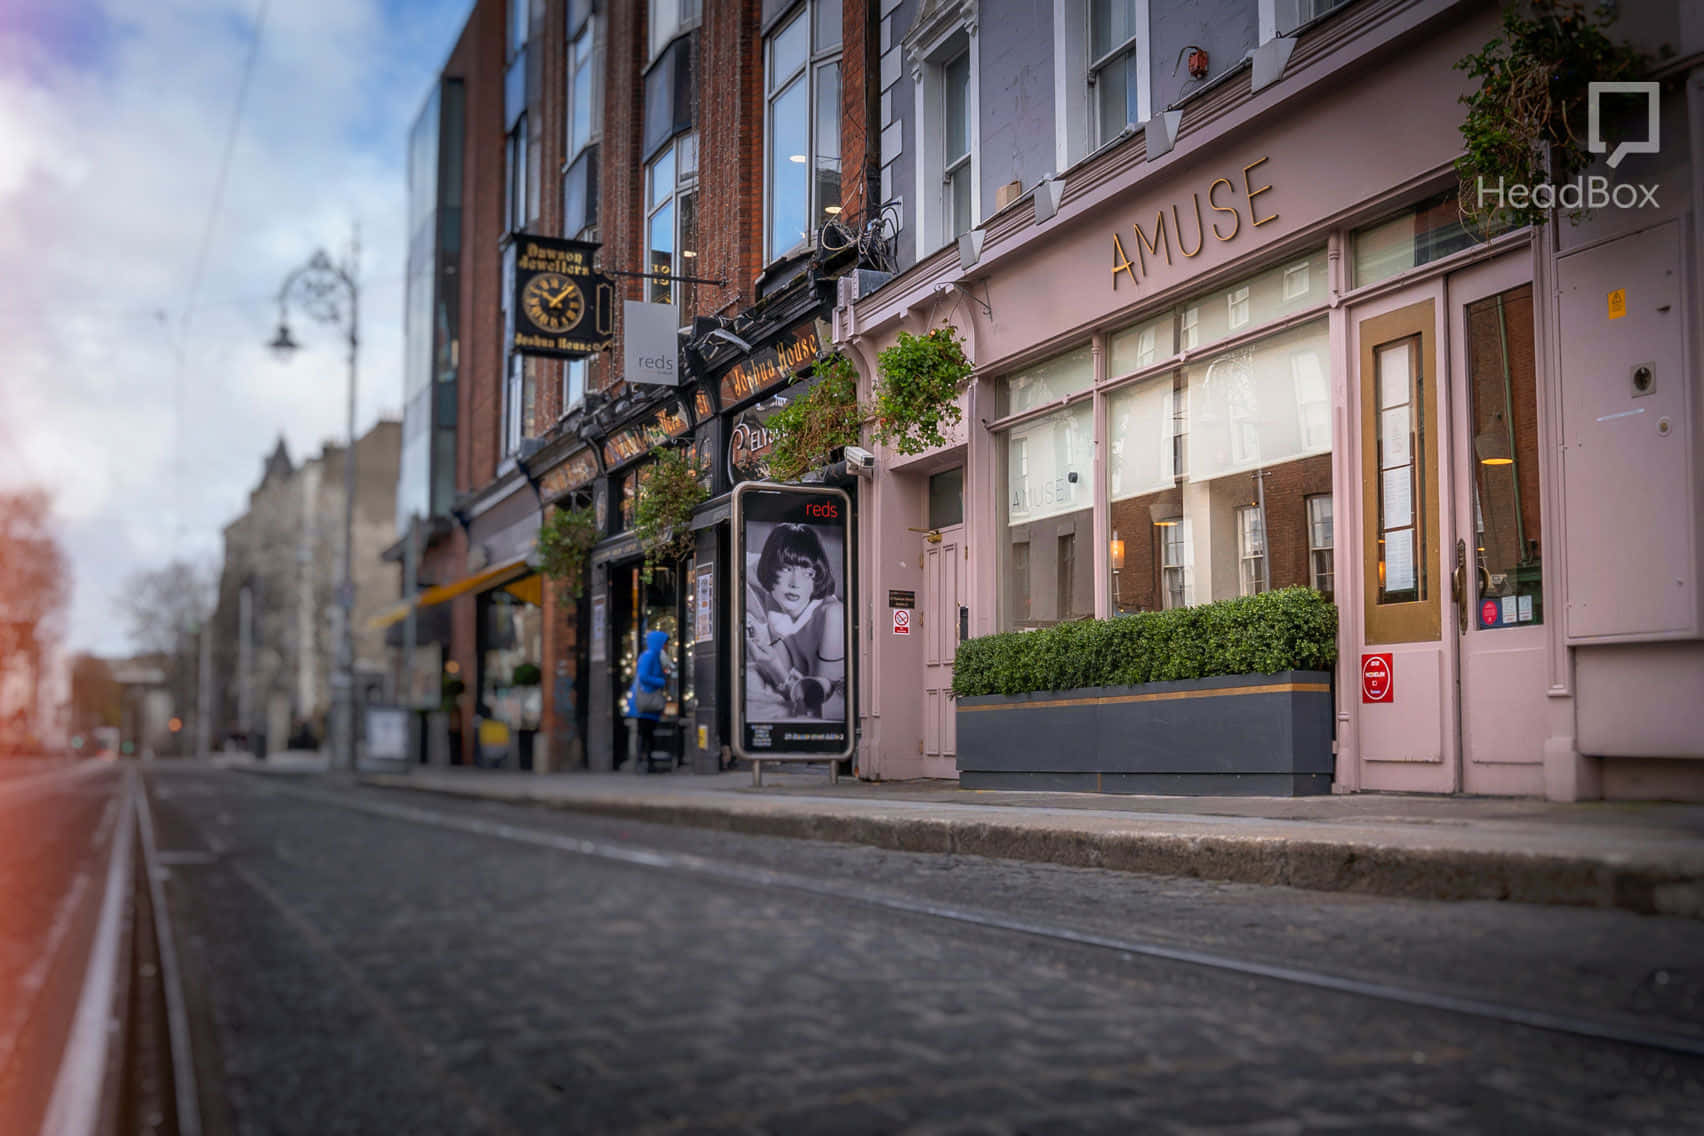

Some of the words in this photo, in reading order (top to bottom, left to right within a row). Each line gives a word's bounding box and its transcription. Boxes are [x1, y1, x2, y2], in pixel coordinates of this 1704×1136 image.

[1112, 156, 1279, 291] AMUSE
[527, 243, 583, 264] Dawson
[519, 254, 590, 276] Jewellers
[638, 354, 673, 370] reds
[734, 359, 776, 396] Joshua
[777, 334, 816, 372] House
[806, 500, 839, 518] reds
